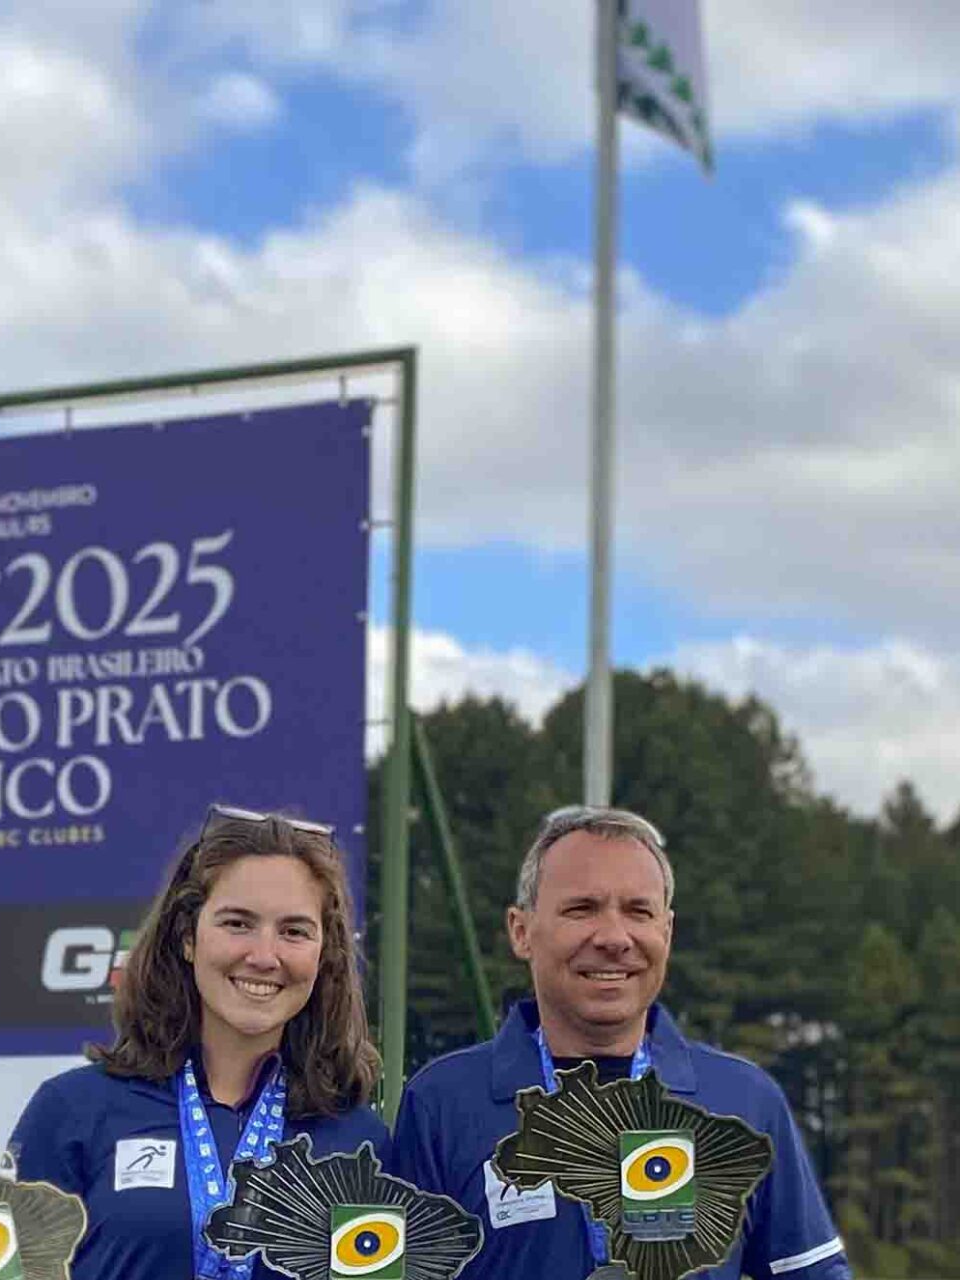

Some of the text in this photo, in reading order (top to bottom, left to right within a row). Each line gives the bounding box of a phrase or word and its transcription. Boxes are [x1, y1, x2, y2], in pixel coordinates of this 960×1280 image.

[46, 645, 205, 684] BRASILEIRO
[55, 676, 273, 749] PRATO
[27, 824, 105, 845] CLUBES
